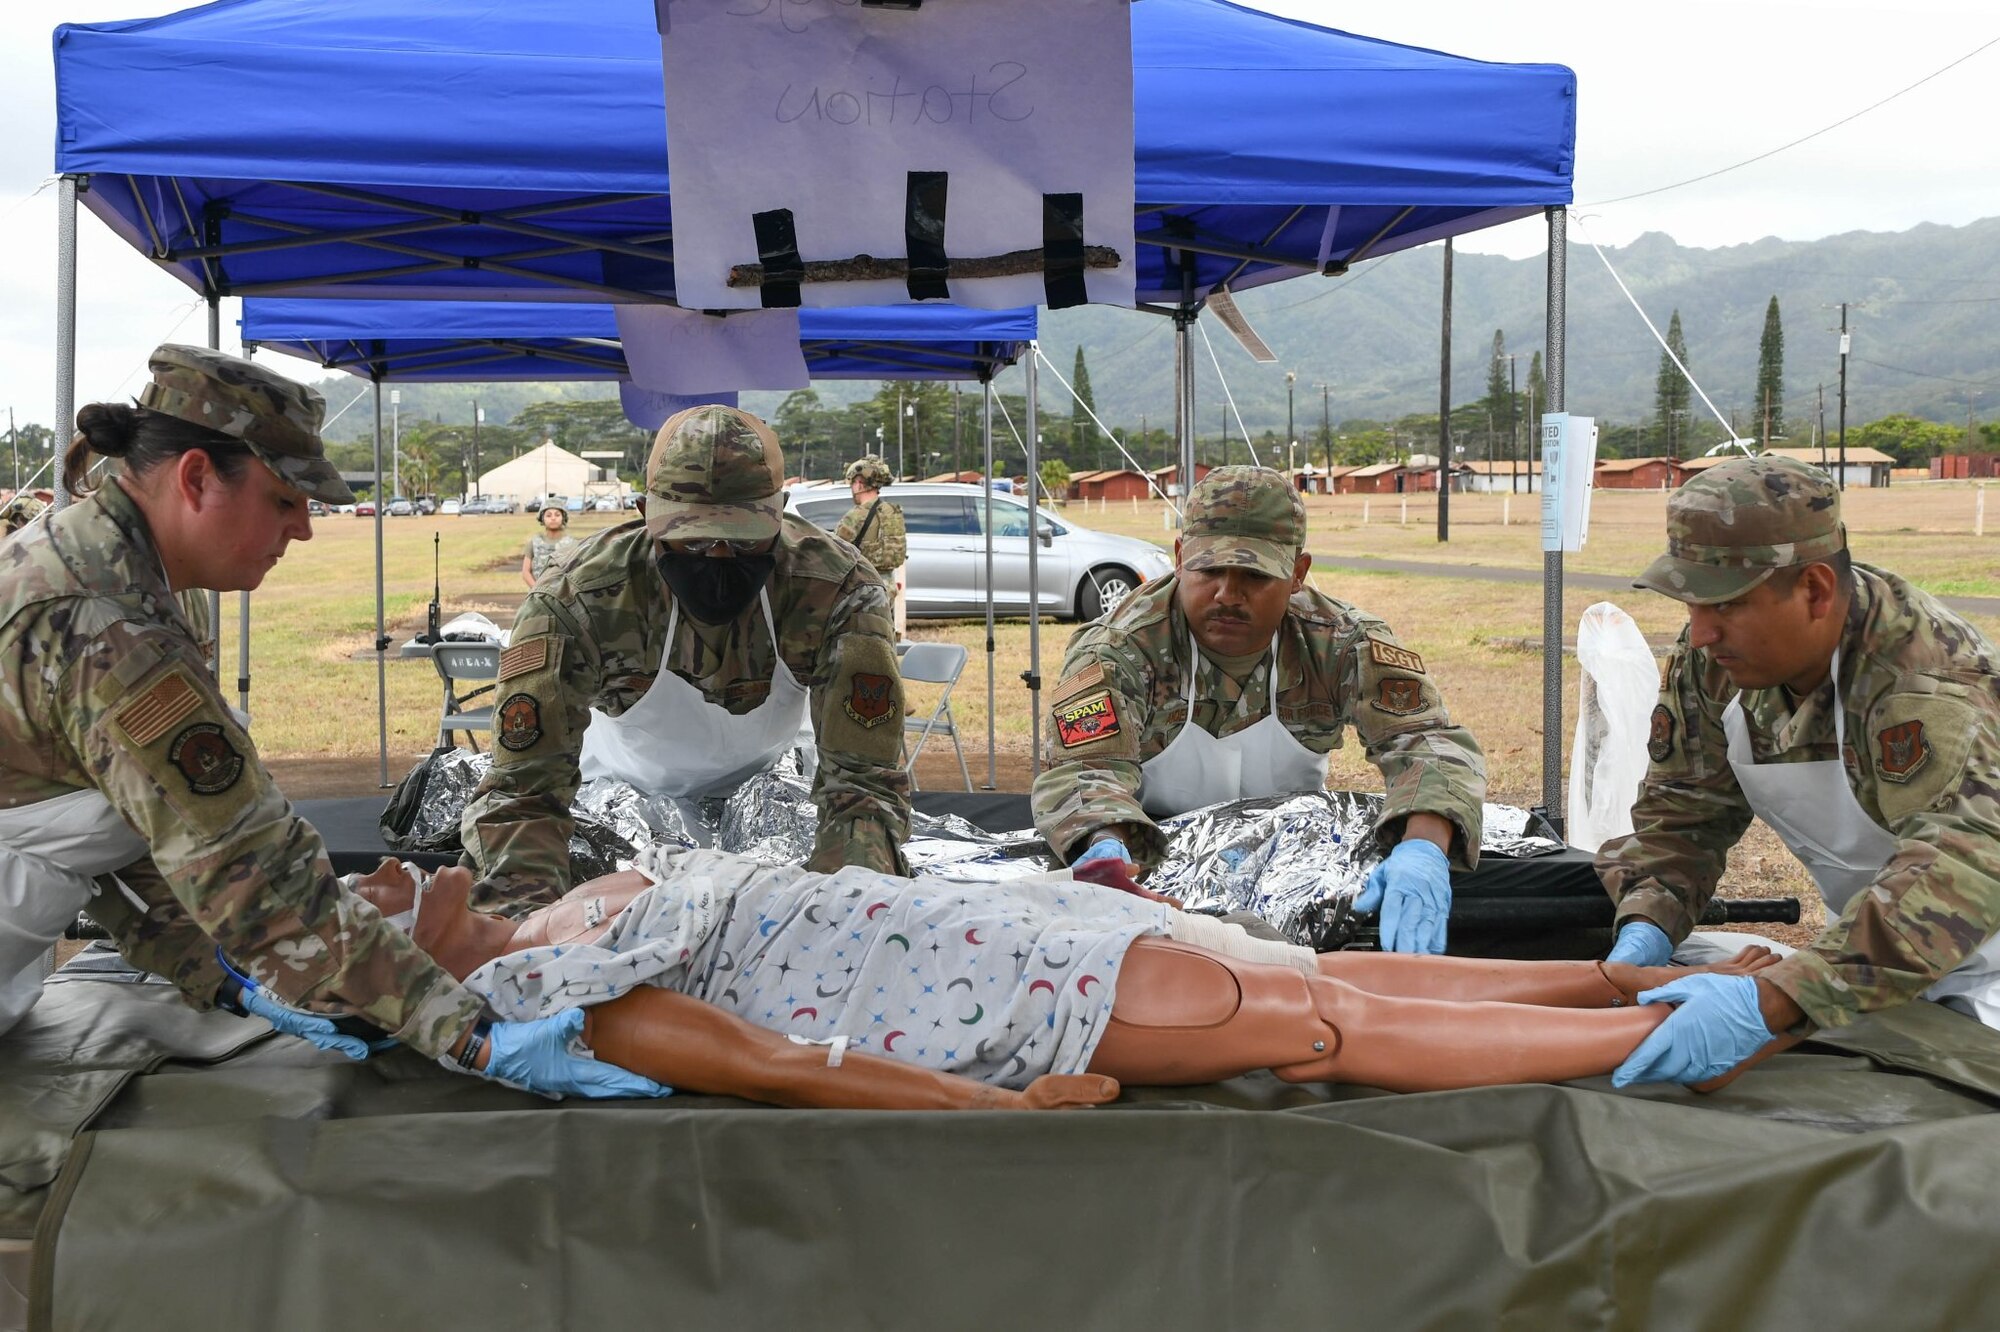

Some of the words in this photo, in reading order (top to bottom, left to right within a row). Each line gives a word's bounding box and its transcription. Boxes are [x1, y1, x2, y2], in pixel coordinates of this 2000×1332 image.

[451, 657, 492, 668] AREA-X
[1373, 643, 1419, 669] 1SGT
[1065, 701, 1106, 722] SPAM
